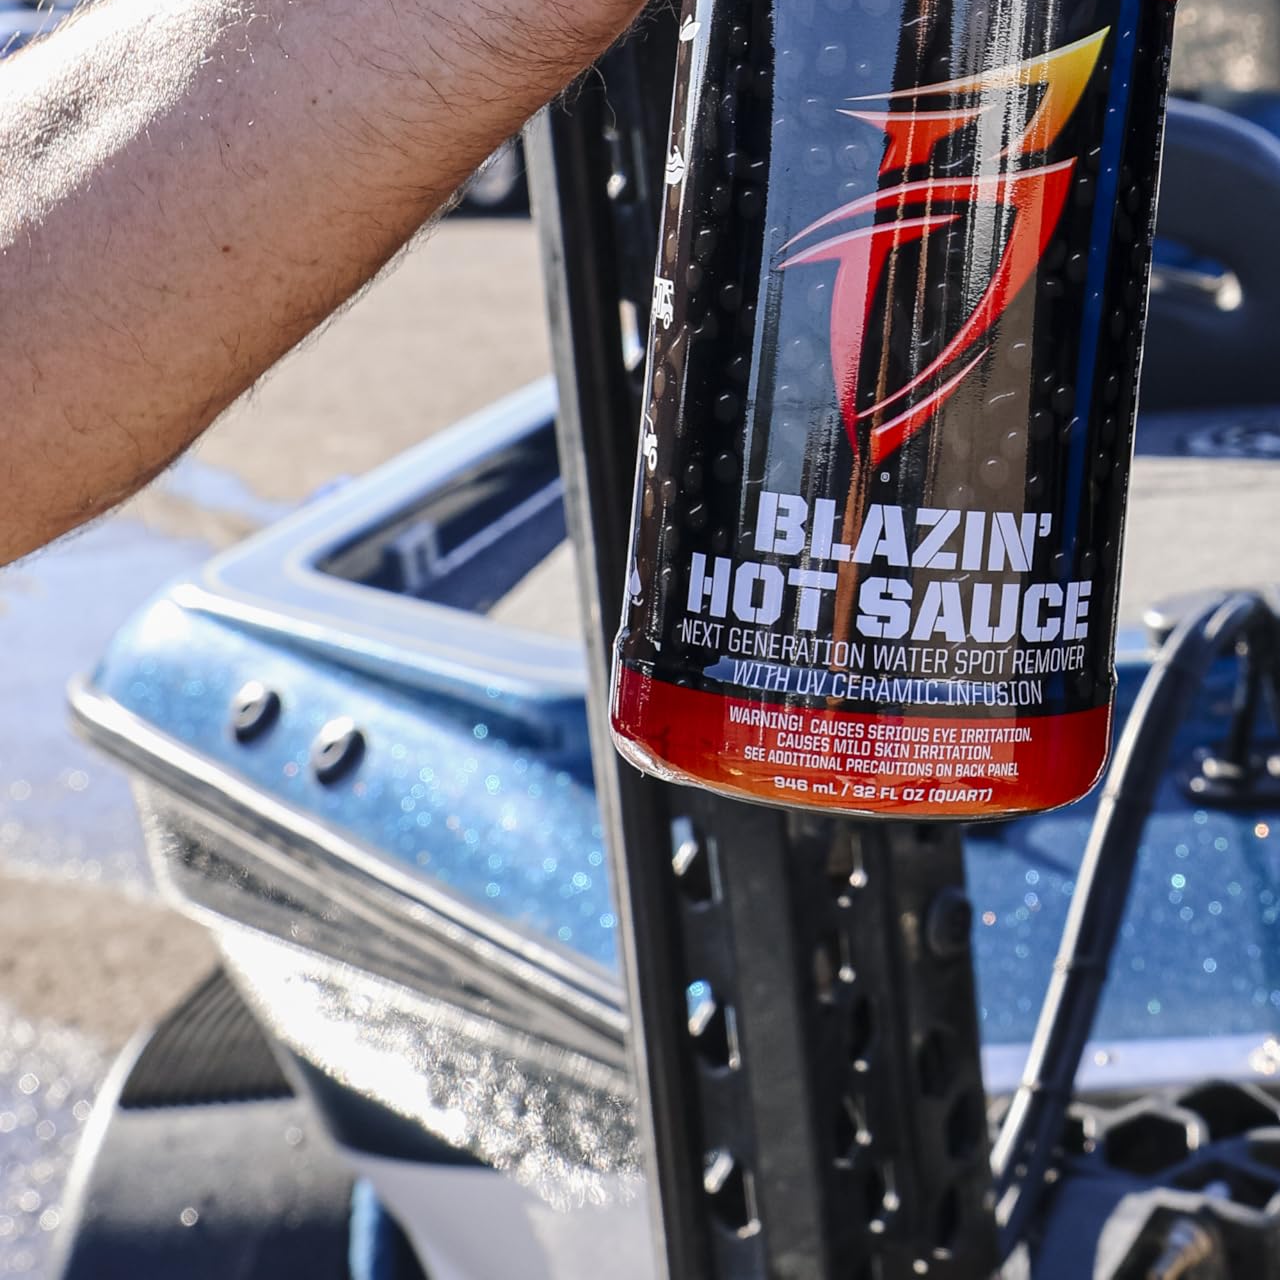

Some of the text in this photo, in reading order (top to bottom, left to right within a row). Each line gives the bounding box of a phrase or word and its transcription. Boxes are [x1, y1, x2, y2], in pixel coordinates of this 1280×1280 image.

[753, 490, 1053, 573] BLAZIN'
[687, 552, 1093, 644] HOT SAUCE
[681, 617, 1085, 675] NEXT GENERATION WATER SPOT REMOVER
[733, 660, 1043, 707] WITH UV CERAMIC INFUSION
[729, 705, 1033, 744] WARNING! CAUSES SERIOUS EYE IRRITATION.
[776, 732, 993, 760] CAUSES MILD SKIN IRRITATION.
[744, 745, 1019, 778] SEE ADDITIONAL PRECAUTIONS ON BACK PANEL
[773, 776, 809, 792] 946
[812, 781, 838, 796] mL
[852, 785, 876, 799] 32
[880, 787, 899, 801] FL
[902, 788, 925, 802] OZ
[928, 788, 993, 804] (QUART)
